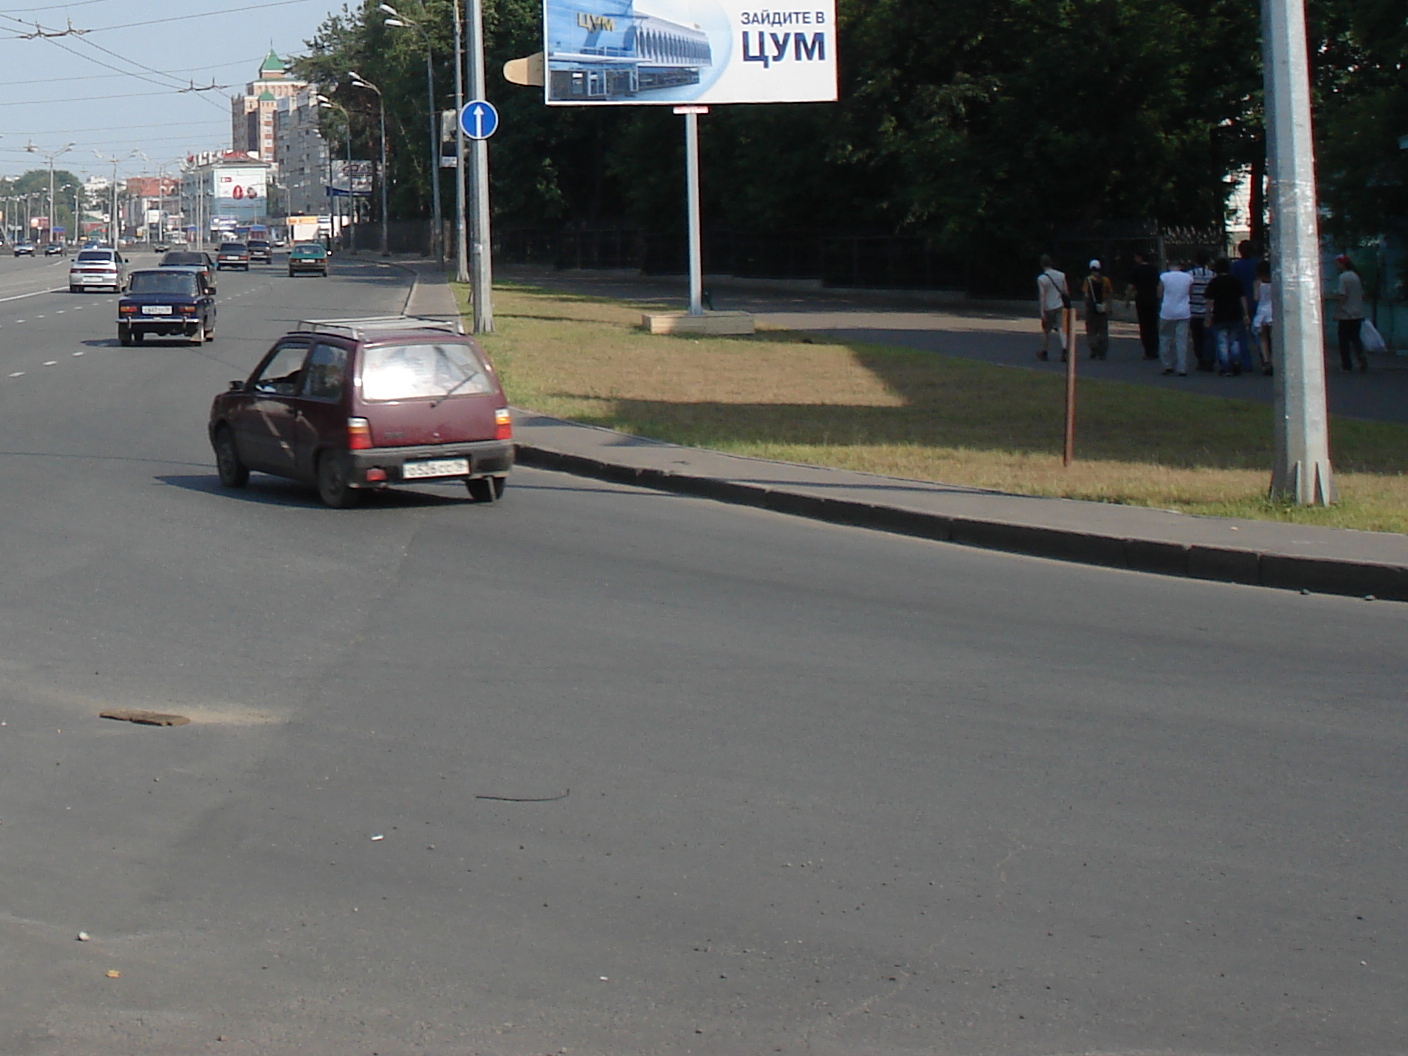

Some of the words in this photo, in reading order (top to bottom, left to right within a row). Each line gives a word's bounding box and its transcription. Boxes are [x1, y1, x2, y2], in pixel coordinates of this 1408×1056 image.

[576, 11, 615, 33] ЦУМ
[741, 9, 810, 27] ЗАЙДИТЕ
[812, 11, 825, 24] В
[742, 31, 826, 69] ЦУМ
